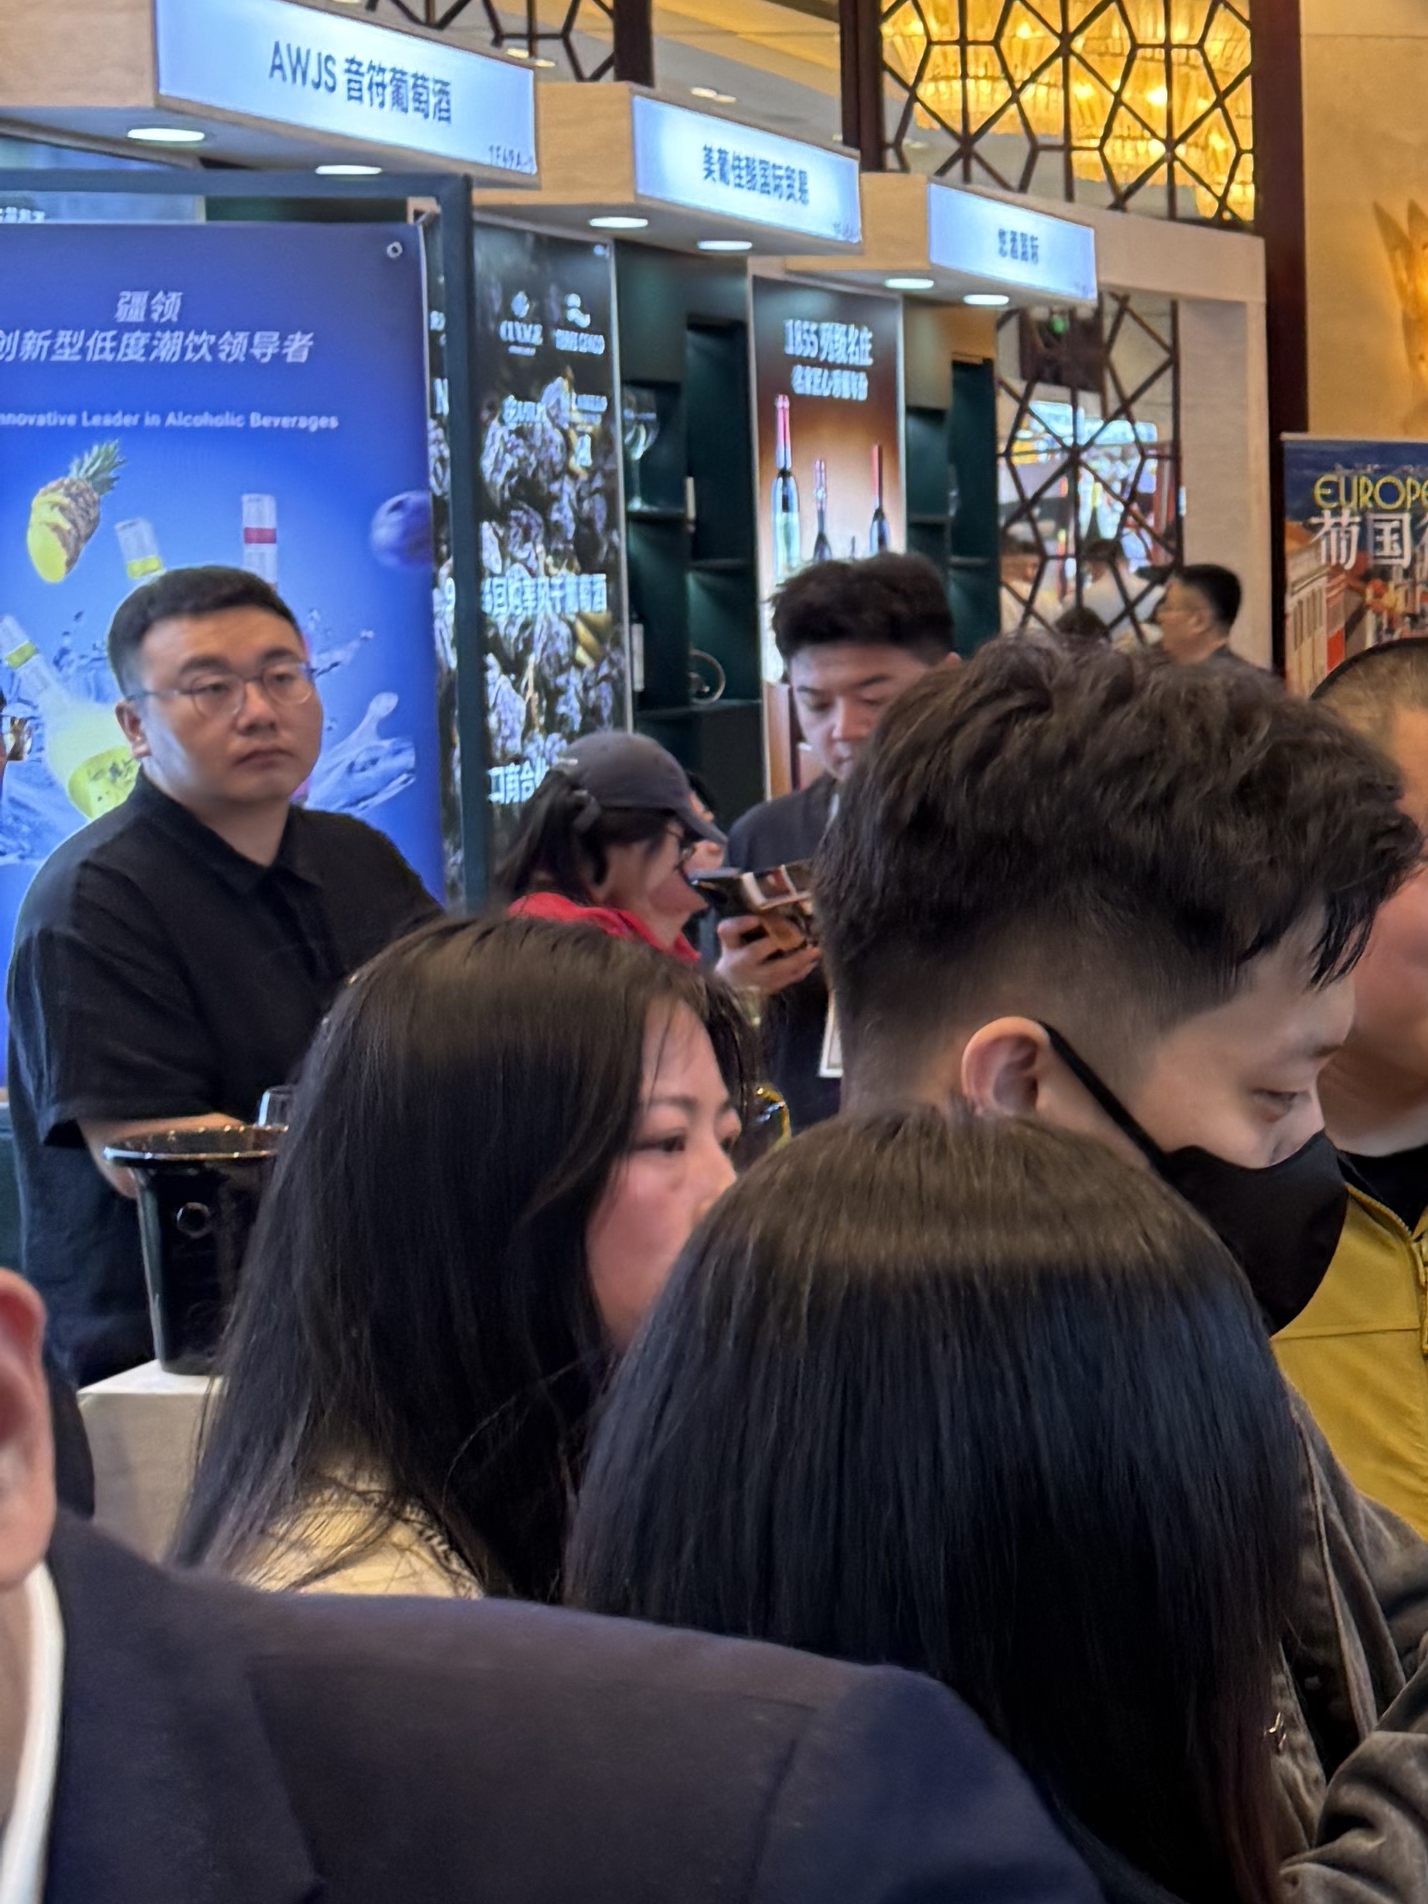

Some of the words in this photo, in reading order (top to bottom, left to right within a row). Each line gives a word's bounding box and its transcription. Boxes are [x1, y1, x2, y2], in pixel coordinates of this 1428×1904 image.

[268, 40, 337, 94] AWJS
[343, 54, 452, 124] 音符葡萄酒
[114, 290, 184, 324] 疆领
[81, 411, 141, 428] Leader
[145, 412, 161, 427] in
[165, 411, 245, 428] Alcoholic
[249, 412, 339, 431] Beverages
